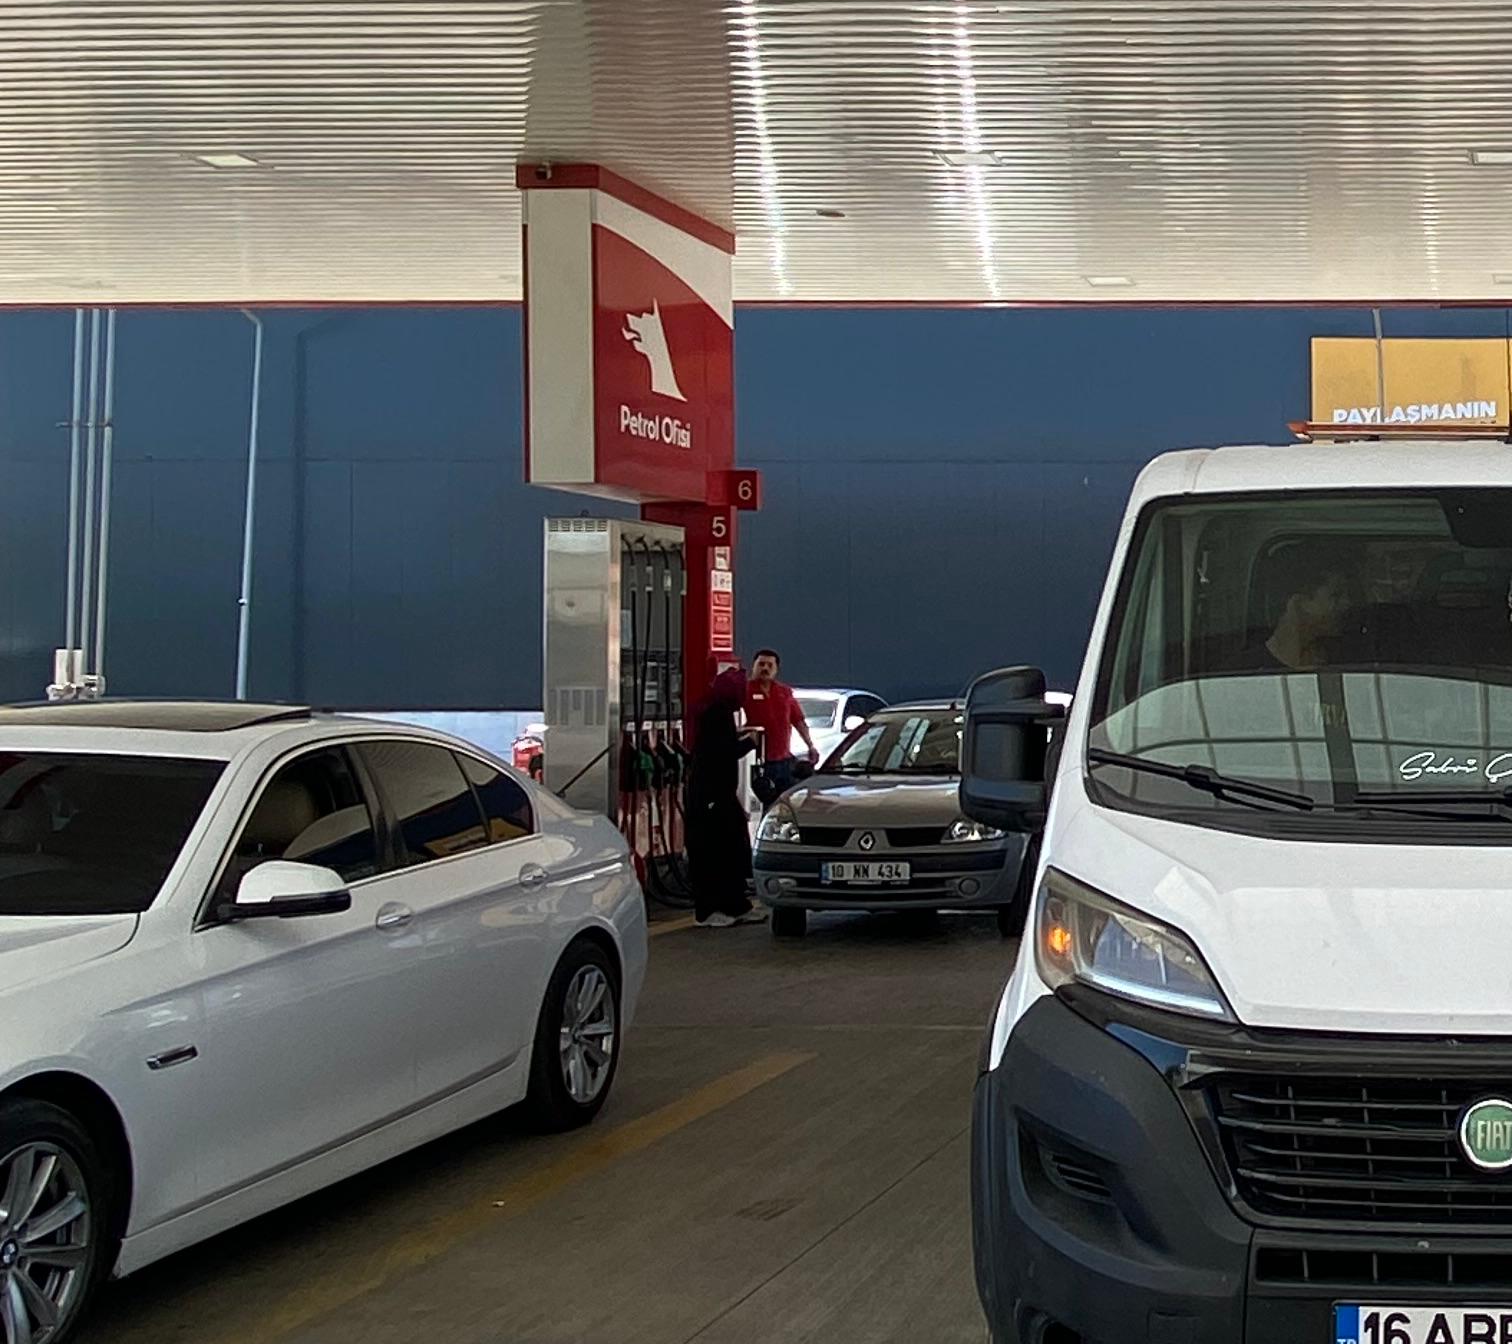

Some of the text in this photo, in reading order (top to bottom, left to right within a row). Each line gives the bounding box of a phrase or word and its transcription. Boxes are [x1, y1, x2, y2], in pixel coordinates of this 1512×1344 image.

[1332, 400, 1498, 424] PAYLAŞMANIN
[620, 404, 691, 449] Petrol Ofisi
[737, 479, 753, 501] 6
[711, 515, 727, 538] 5
